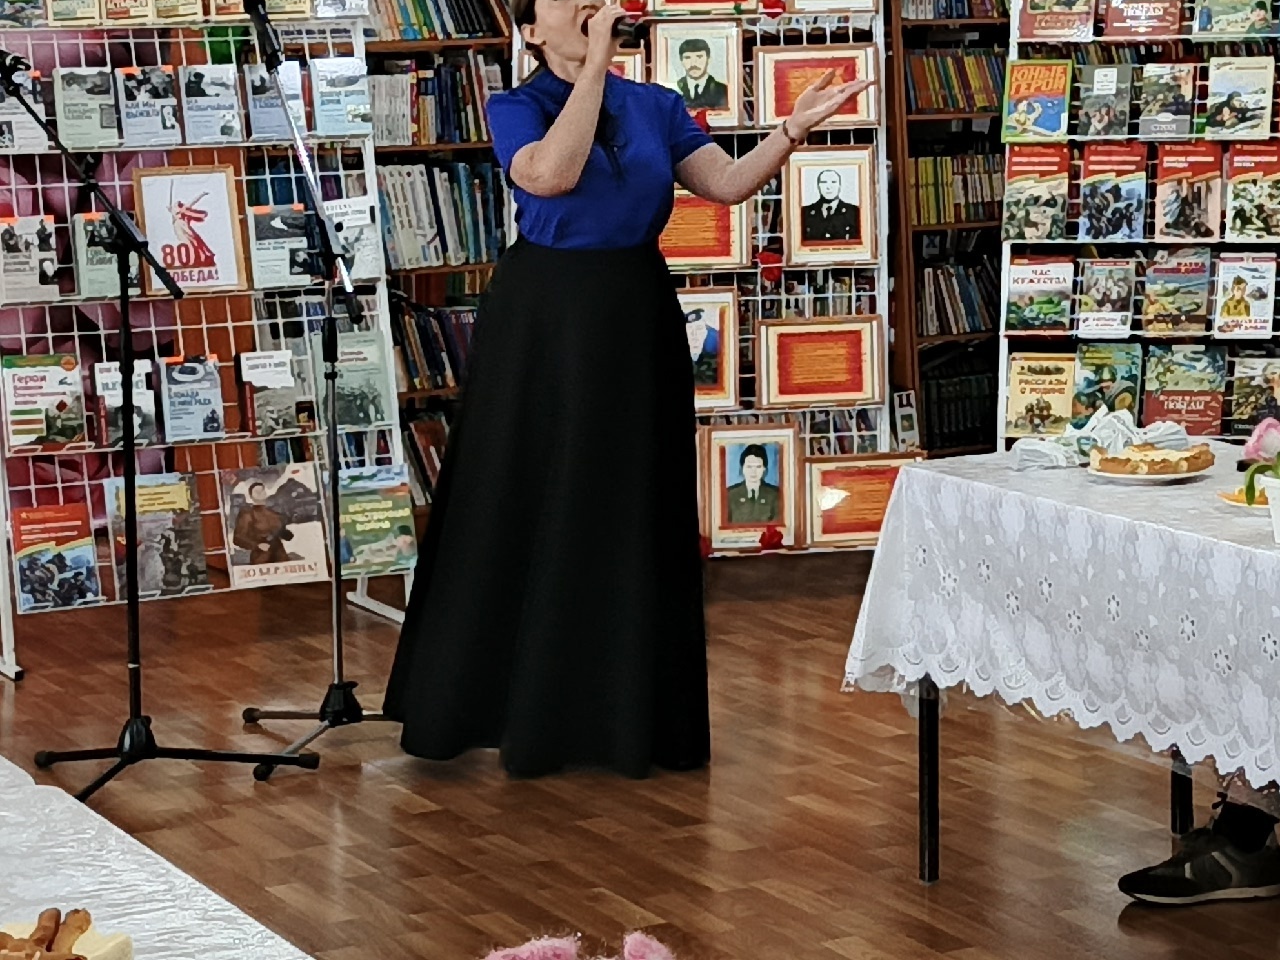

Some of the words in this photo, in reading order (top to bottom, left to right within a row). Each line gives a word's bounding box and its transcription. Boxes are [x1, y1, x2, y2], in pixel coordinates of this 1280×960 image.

[1011, 65, 1064, 82] ЮНЫЕ
[1010, 77, 1066, 95] ГЕРОИ
[161, 242, 190, 267] 80
[167, 268, 219, 283] ОБЕДА!
